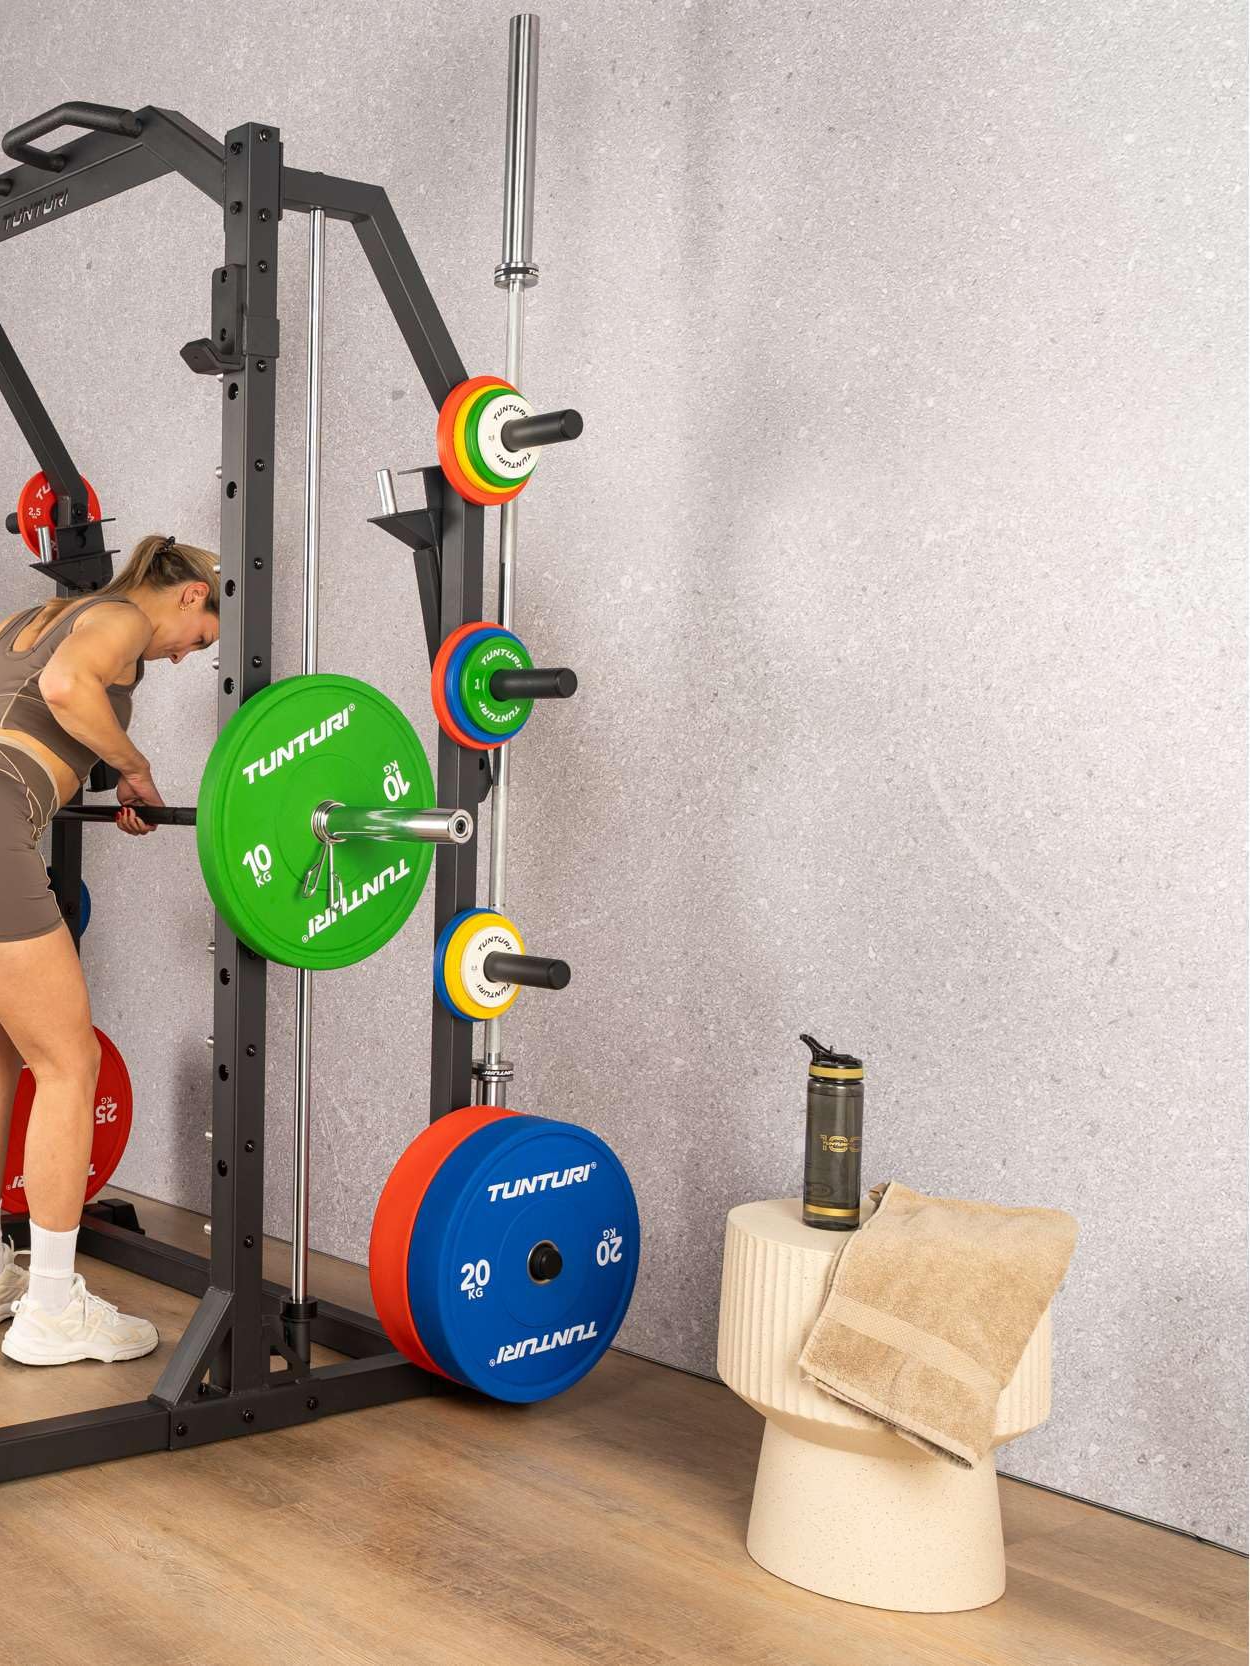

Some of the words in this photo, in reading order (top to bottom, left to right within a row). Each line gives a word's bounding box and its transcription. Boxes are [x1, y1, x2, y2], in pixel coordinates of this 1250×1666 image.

[3, 188, 69, 232] TUNTURI
[383, 760, 399, 776] KG
[383, 773, 411, 802] 10
[242, 844, 273, 877] 10
[255, 871, 273, 888] KG
[95, 1103, 118, 1125] 25
[602, 1227, 617, 1240] KG
[596, 1236, 623, 1267] 20
[460, 1258, 491, 1292] 20
[468, 1288, 484, 1300] KG
